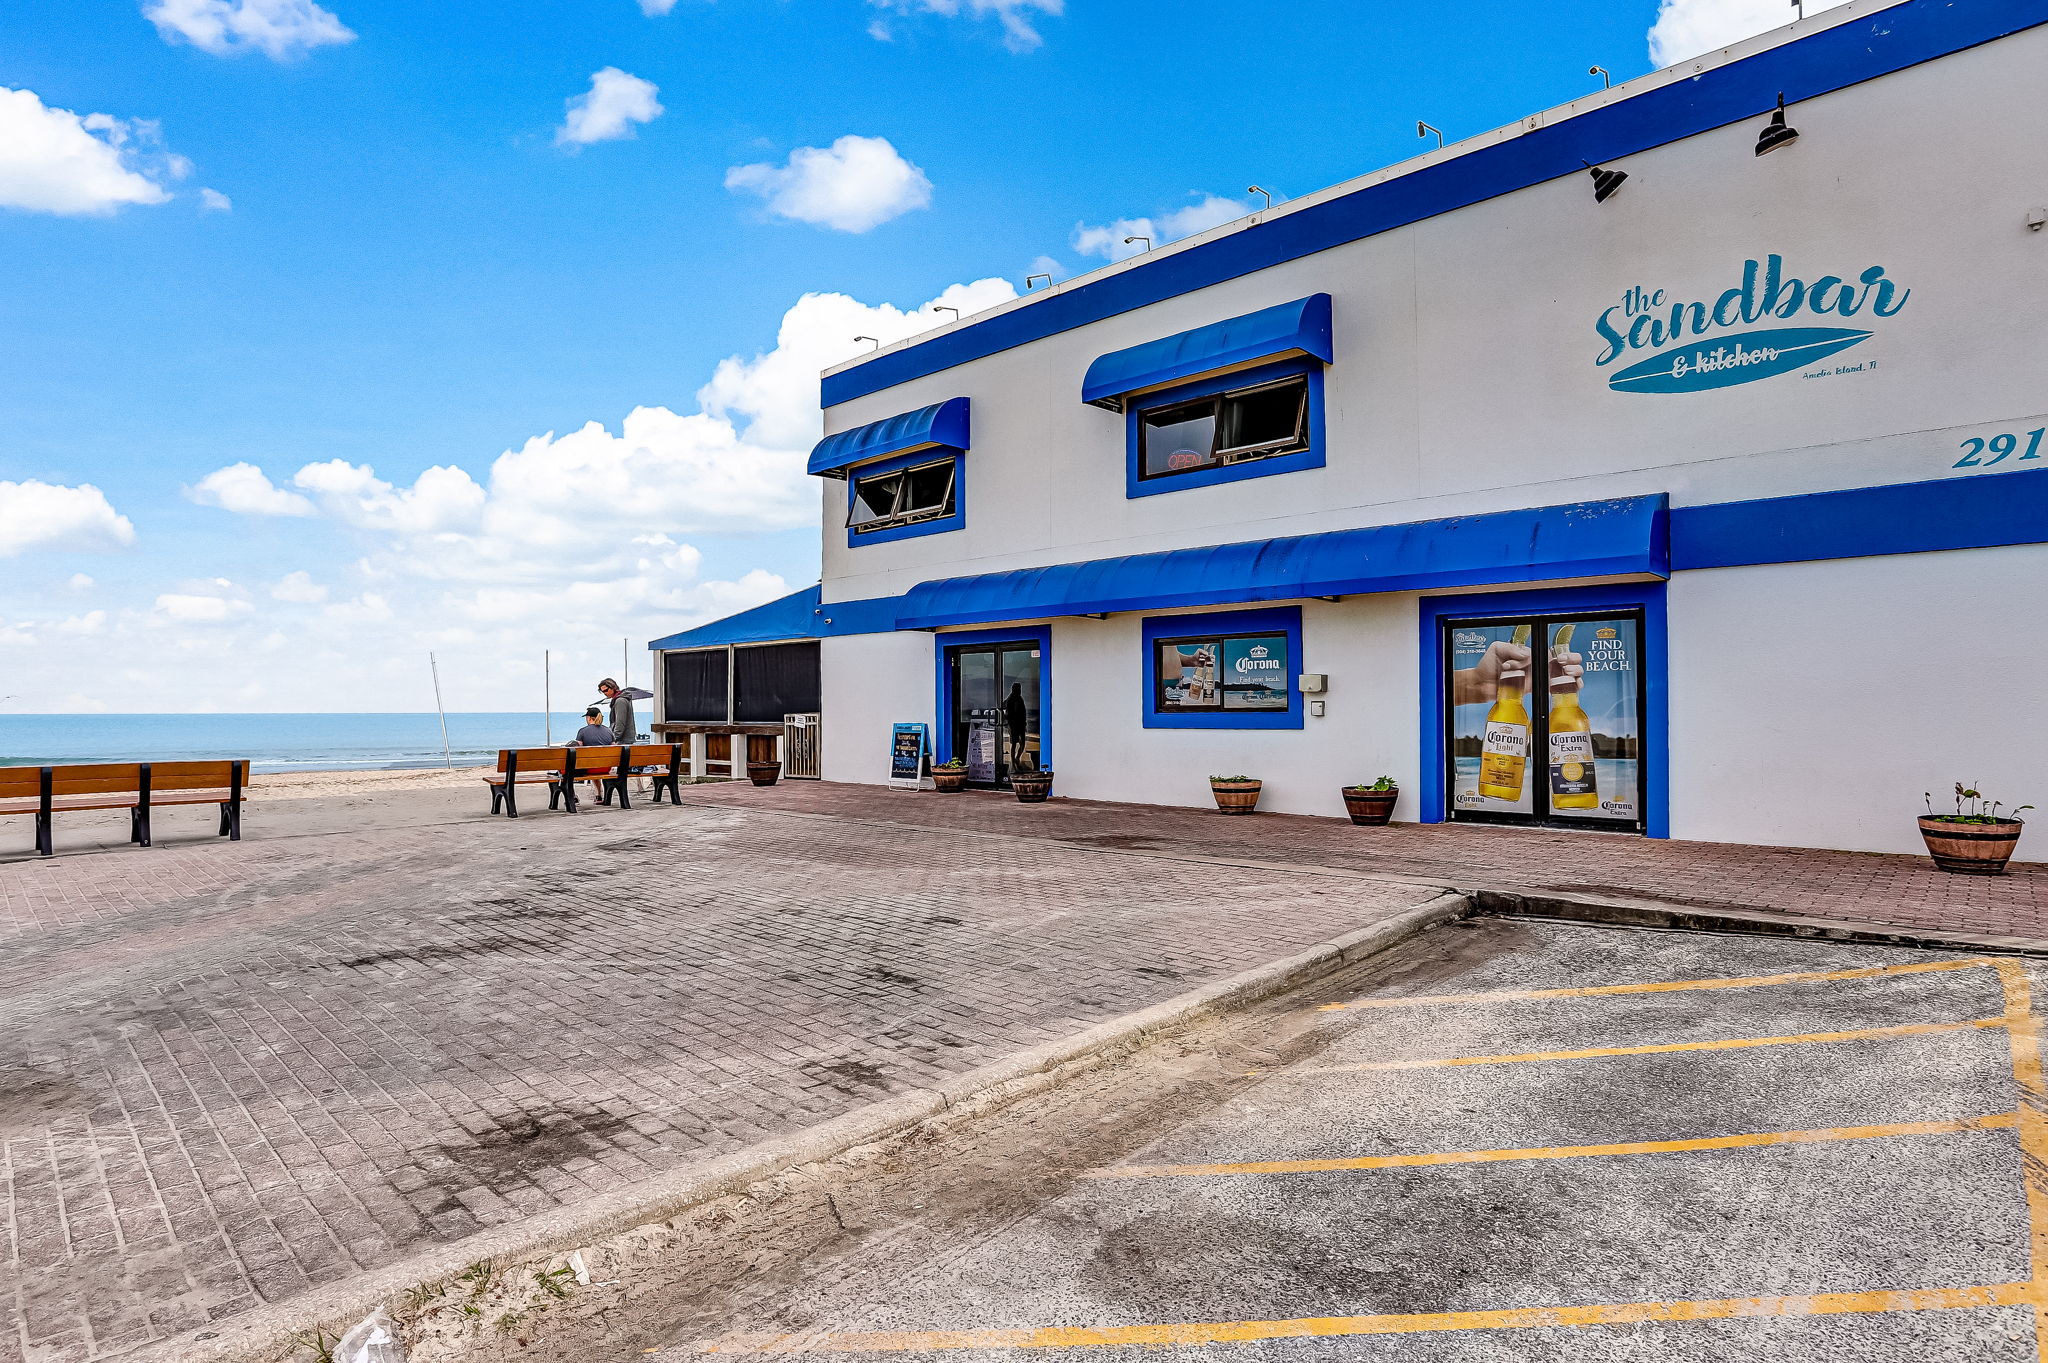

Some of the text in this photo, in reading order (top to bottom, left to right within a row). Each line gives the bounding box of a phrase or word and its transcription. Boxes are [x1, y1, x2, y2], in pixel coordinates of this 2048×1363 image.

[1621, 285, 1668, 317] the
[1596, 254, 1911, 366] Sandbar
[1672, 343, 1780, 378] & kitchen
[1802, 369, 1832, 380] Amelia
[1951, 427, 2046, 469] 291
[1168, 453, 1202, 470] OPEN
[1591, 639, 1623, 651] FIND
[1588, 649, 1626, 661] YOUR
[1235, 657, 1280, 674] Corona
[1239, 675, 1251, 683] Find
[1487, 730, 1525, 746] Corona
[1550, 734, 1589, 747] Corona
[1495, 742, 1514, 752] Light
[1560, 744, 1583, 752] Extra
[1456, 794, 1485, 804] Corona
[1601, 800, 1633, 811] Corona
